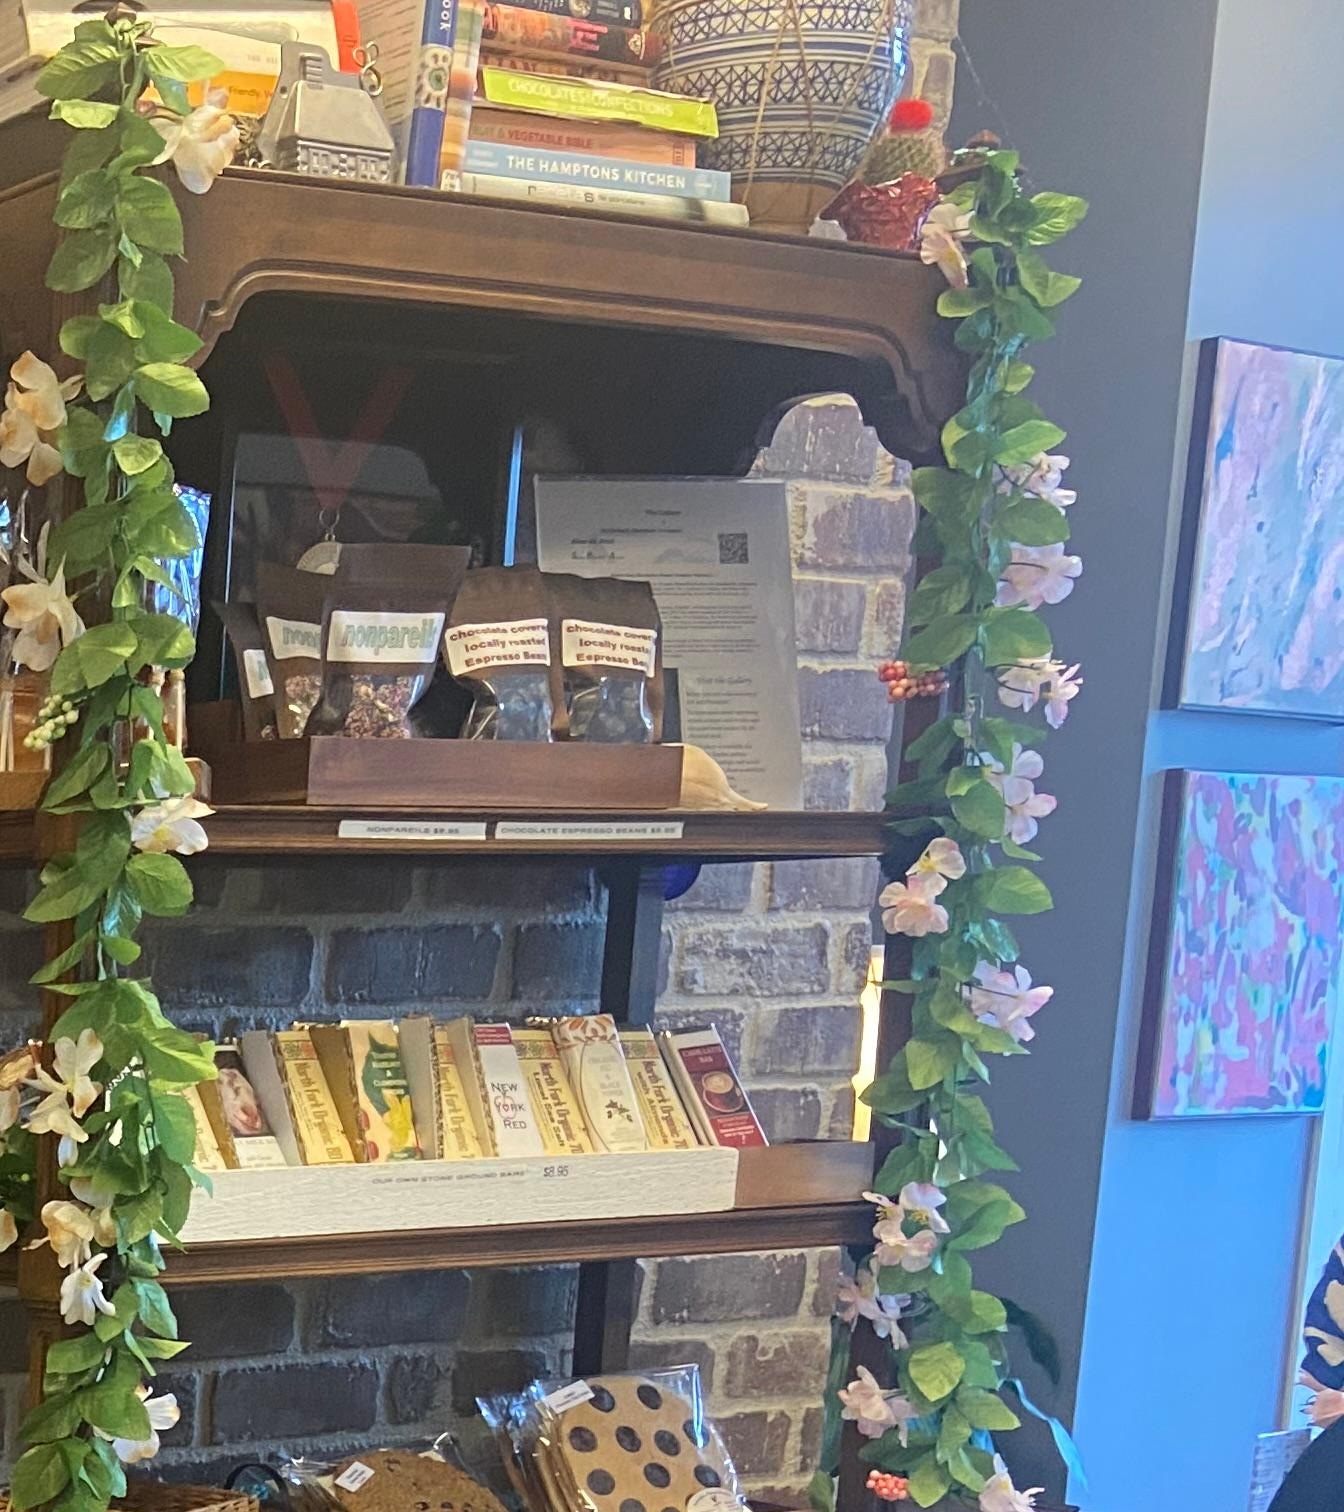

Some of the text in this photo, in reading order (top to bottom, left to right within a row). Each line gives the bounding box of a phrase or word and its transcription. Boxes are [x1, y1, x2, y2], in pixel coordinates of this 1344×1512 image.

[508, 129, 594, 150] VEGETABLE BIBLE
[507, 156, 685, 190] THE HAMPTONS KITCHEN
[449, 625, 505, 641] chocolate
[566, 624, 621, 638] chocolate
[465, 638, 507, 653] locally
[579, 638, 617, 651] locally
[465, 653, 520, 668] Espresso
[576, 652, 629, 666] Espresso
[642, 1060, 660, 1083] North
[491, 1081, 518, 1093] NEW
[294, 1062, 335, 1147] North Fork Organic
[539, 1061, 558, 1084] North
[556, 1105, 576, 1144] Organic
[503, 1119, 527, 1130] RED
